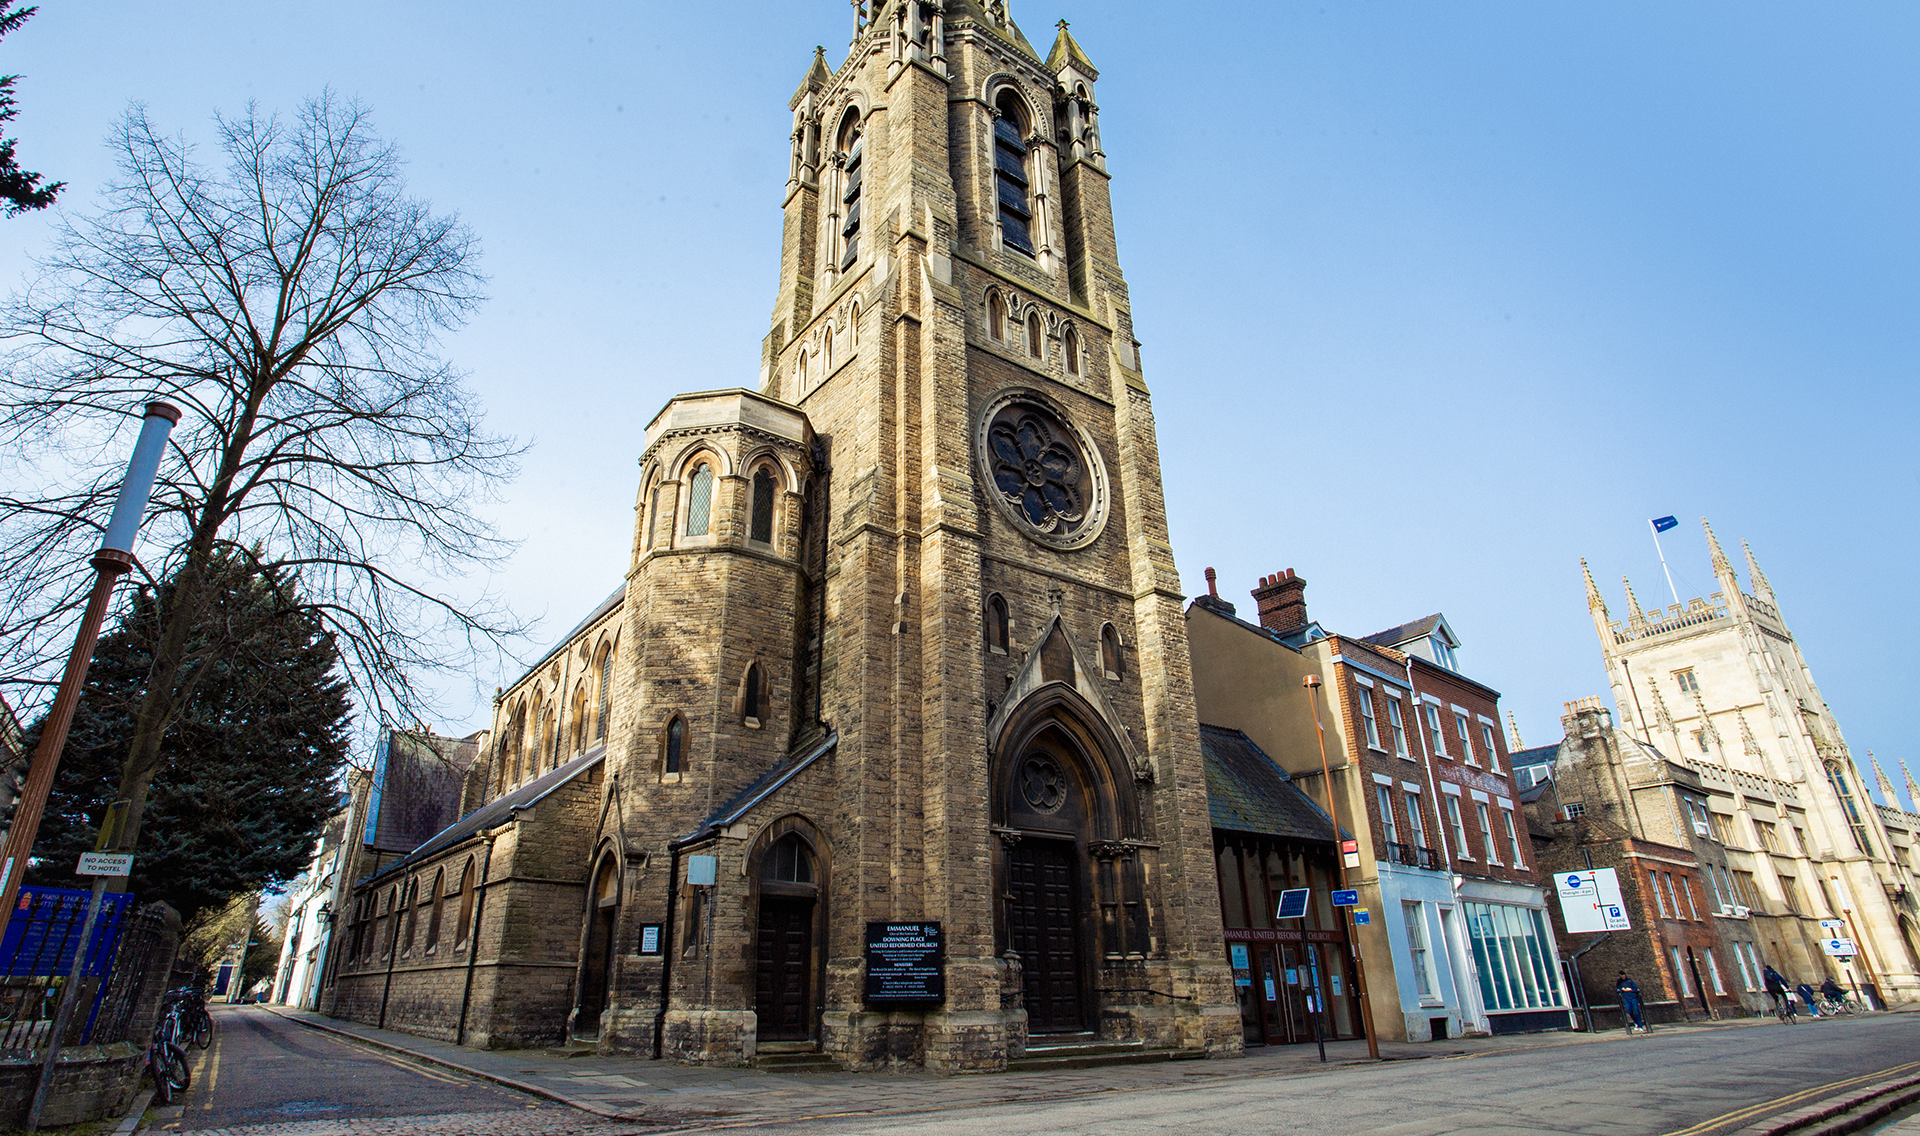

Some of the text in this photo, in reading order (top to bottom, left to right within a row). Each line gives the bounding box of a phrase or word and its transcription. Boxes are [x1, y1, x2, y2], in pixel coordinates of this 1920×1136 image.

[1224, 930, 1330, 940] MMANUEL UNITED REFORME CHURCH
